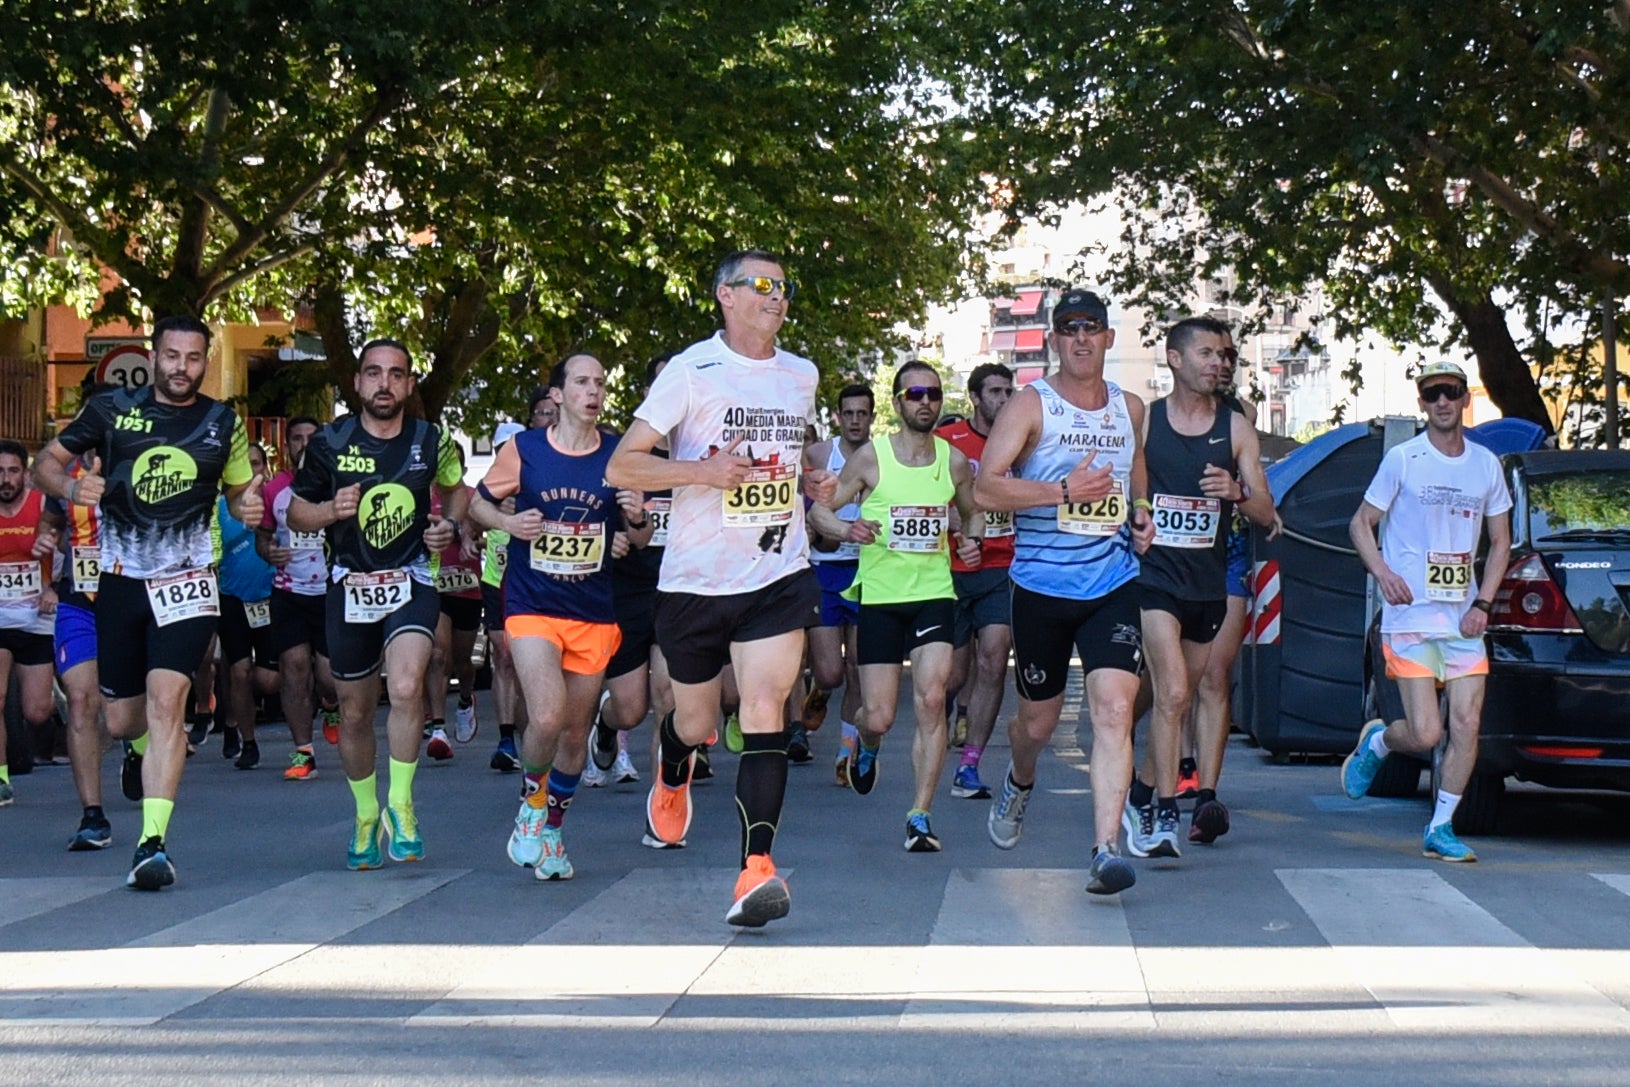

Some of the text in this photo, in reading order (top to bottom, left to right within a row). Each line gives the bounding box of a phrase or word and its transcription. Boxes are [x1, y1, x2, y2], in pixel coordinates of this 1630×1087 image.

[111, 366, 149, 388] 30
[115, 415, 153, 433] 1951
[723, 407, 744, 427] 40
[746, 415, 774, 427] MEDIA
[761, 429, 773, 441] DE
[1060, 433, 1125, 447] MARACENA
[337, 454, 376, 473] 2503
[541, 487, 604, 510] RUNNERS
[728, 482, 790, 508] 3690
[1066, 496, 1119, 517] 1826
[893, 519, 941, 536] 5883
[1157, 509, 1211, 531] 3053
[534, 534, 595, 558] 4237
[76, 560, 99, 577] 13
[1555, 561, 1611, 569] MONDEO
[154, 579, 212, 608] 1828
[350, 585, 402, 606] 1582
[248, 602, 270, 618] 15
